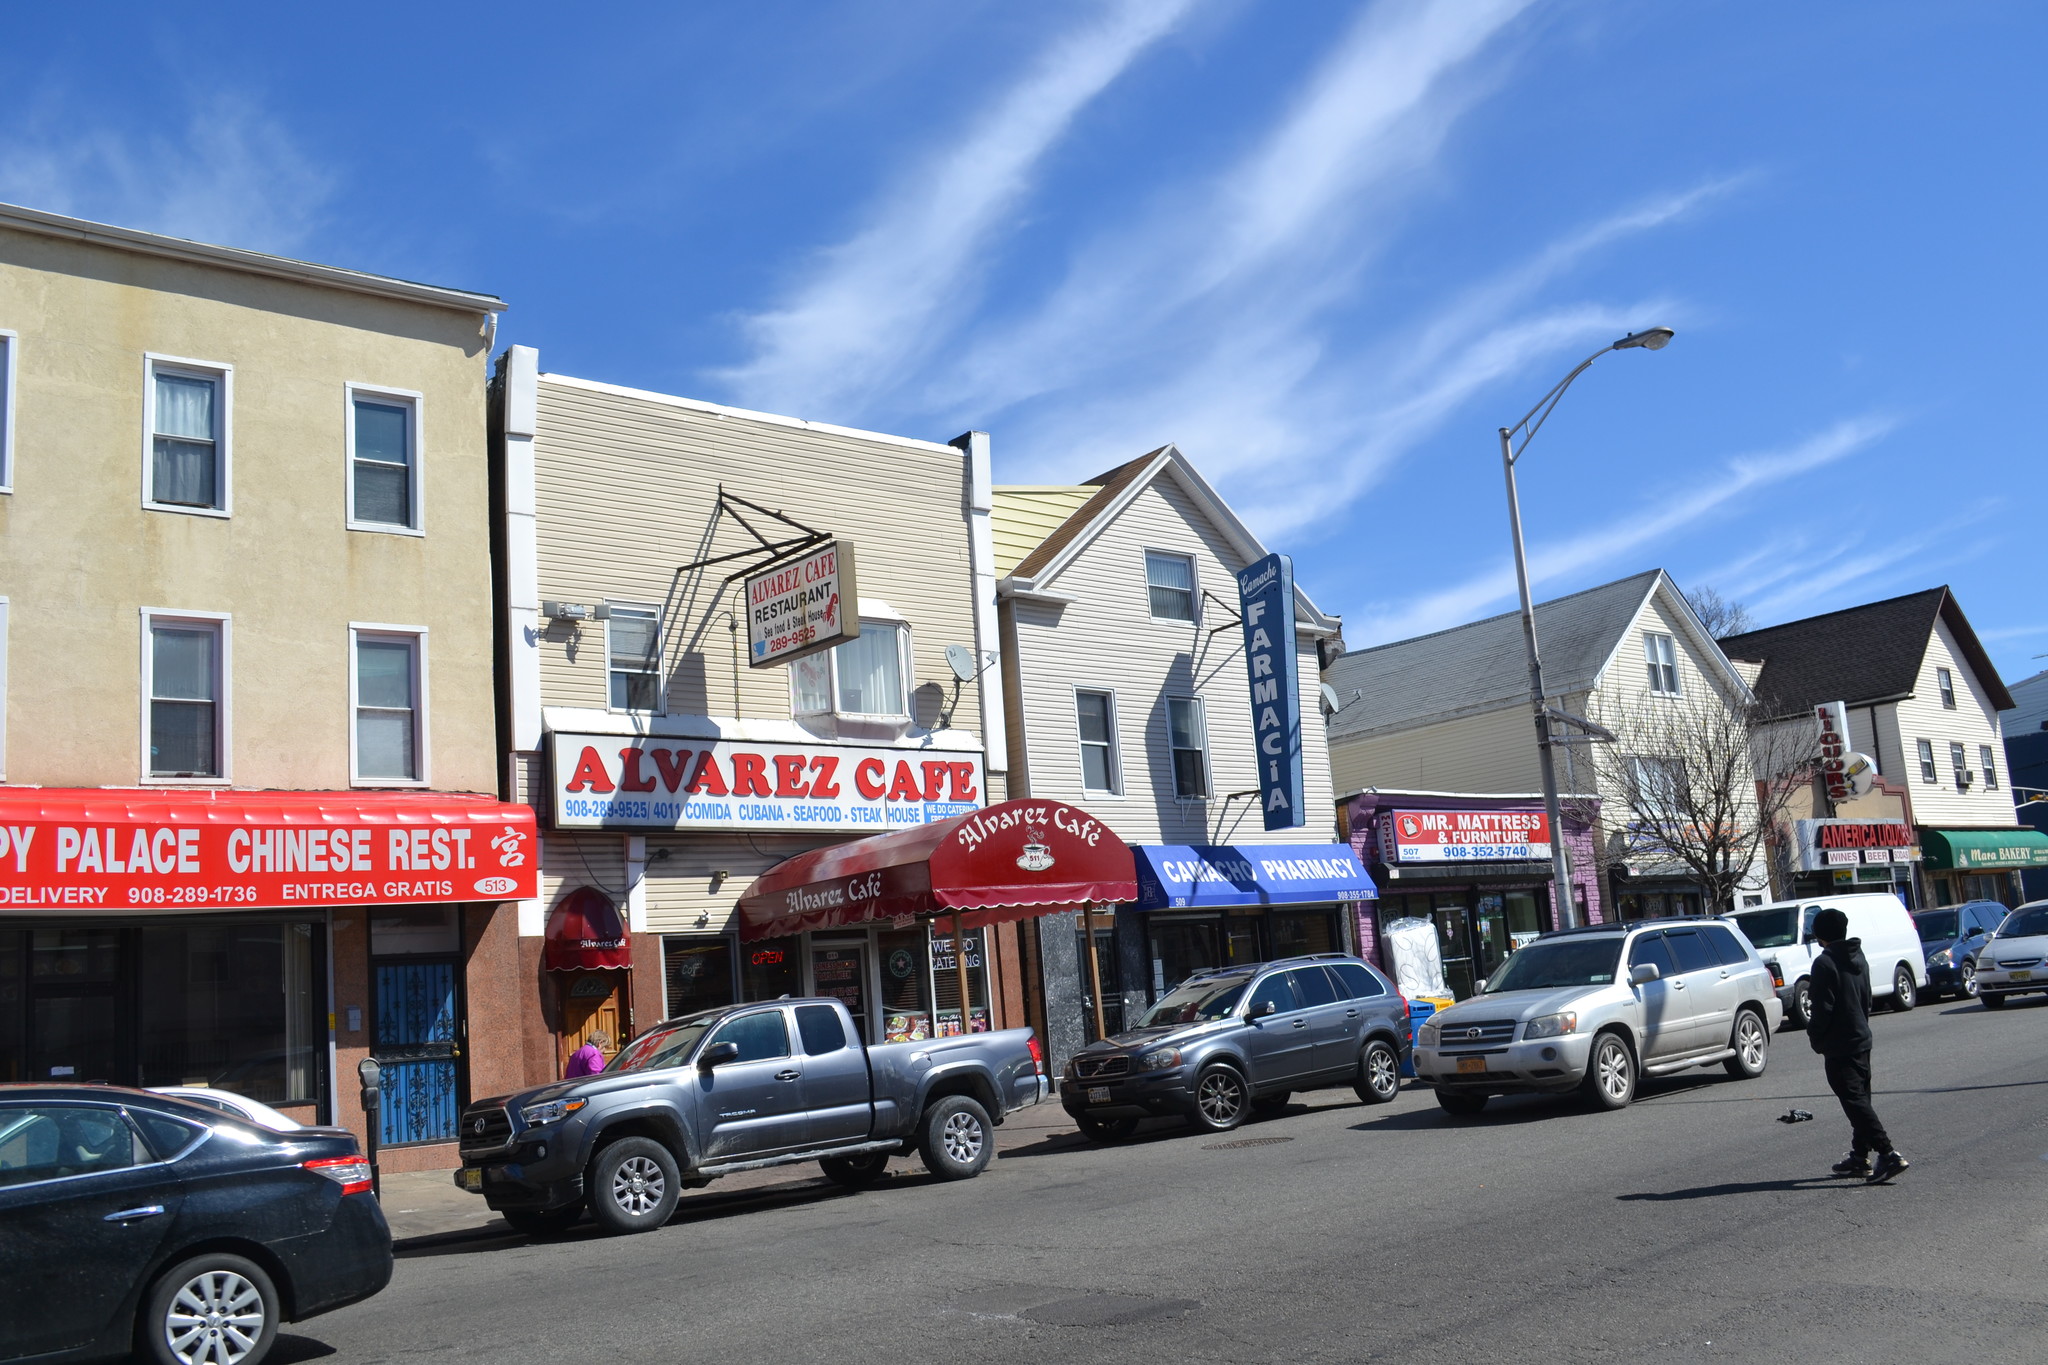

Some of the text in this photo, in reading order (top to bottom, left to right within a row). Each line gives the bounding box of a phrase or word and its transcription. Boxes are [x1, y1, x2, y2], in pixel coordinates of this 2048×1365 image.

[752, 552, 836, 606] ALVAREZ CAFE
[1240, 561, 1277, 596] Camacho
[755, 582, 832, 625] RESTAURANT
[808, 609, 824, 622] House
[770, 625, 816, 652] 289-9525
[1247, 600, 1289, 812] FARMACIA
[565, 745, 978, 802] ALVAREZ CAFE
[685, 803, 732, 820] COMIDA
[739, 803, 784, 821] CUBANA
[793, 805, 842, 823] SEAFOOD
[850, 806, 882, 823] STEAK
[887, 807, 921, 824] HOUSE
[926, 805, 936, 814] WE
[938, 805, 946, 814] DO
[958, 807, 1101, 852] Alvarez Café
[1422, 814, 1541, 830] MR. MATTRESS
[1381, 815, 1395, 861] MATTRESS
[1437, 831, 1529, 844] & FURNITURE
[1822, 825, 1878, 848] AMERICA
[57, 827, 200, 874] PALACE
[227, 828, 372, 873] CHINESE
[389, 828, 475, 871] REST.
[1403, 846, 1527, 857] 507 908-352-5740
[1829, 850, 1909, 863] WINES BEER SODAS
[1970, 848, 1997, 861] Mara
[1998, 847, 2031, 860] BAKERY
[1162, 858, 1358, 883] CAMACHO PHARMACY
[128, 886, 257, 903] 908-289-1736
[282, 883, 377, 899] ENTREGA
[383, 881, 453, 897] GRATIS
[484, 880, 507, 892] 513
[786, 872, 881, 914] Alvarez Café
[1175, 897, 1186, 906] 509
[931, 940, 956, 953] WE
[752, 951, 784, 965] OPEN
[932, 954, 980, 970] CATENG
[718, 1109, 757, 1117] TACOMA
